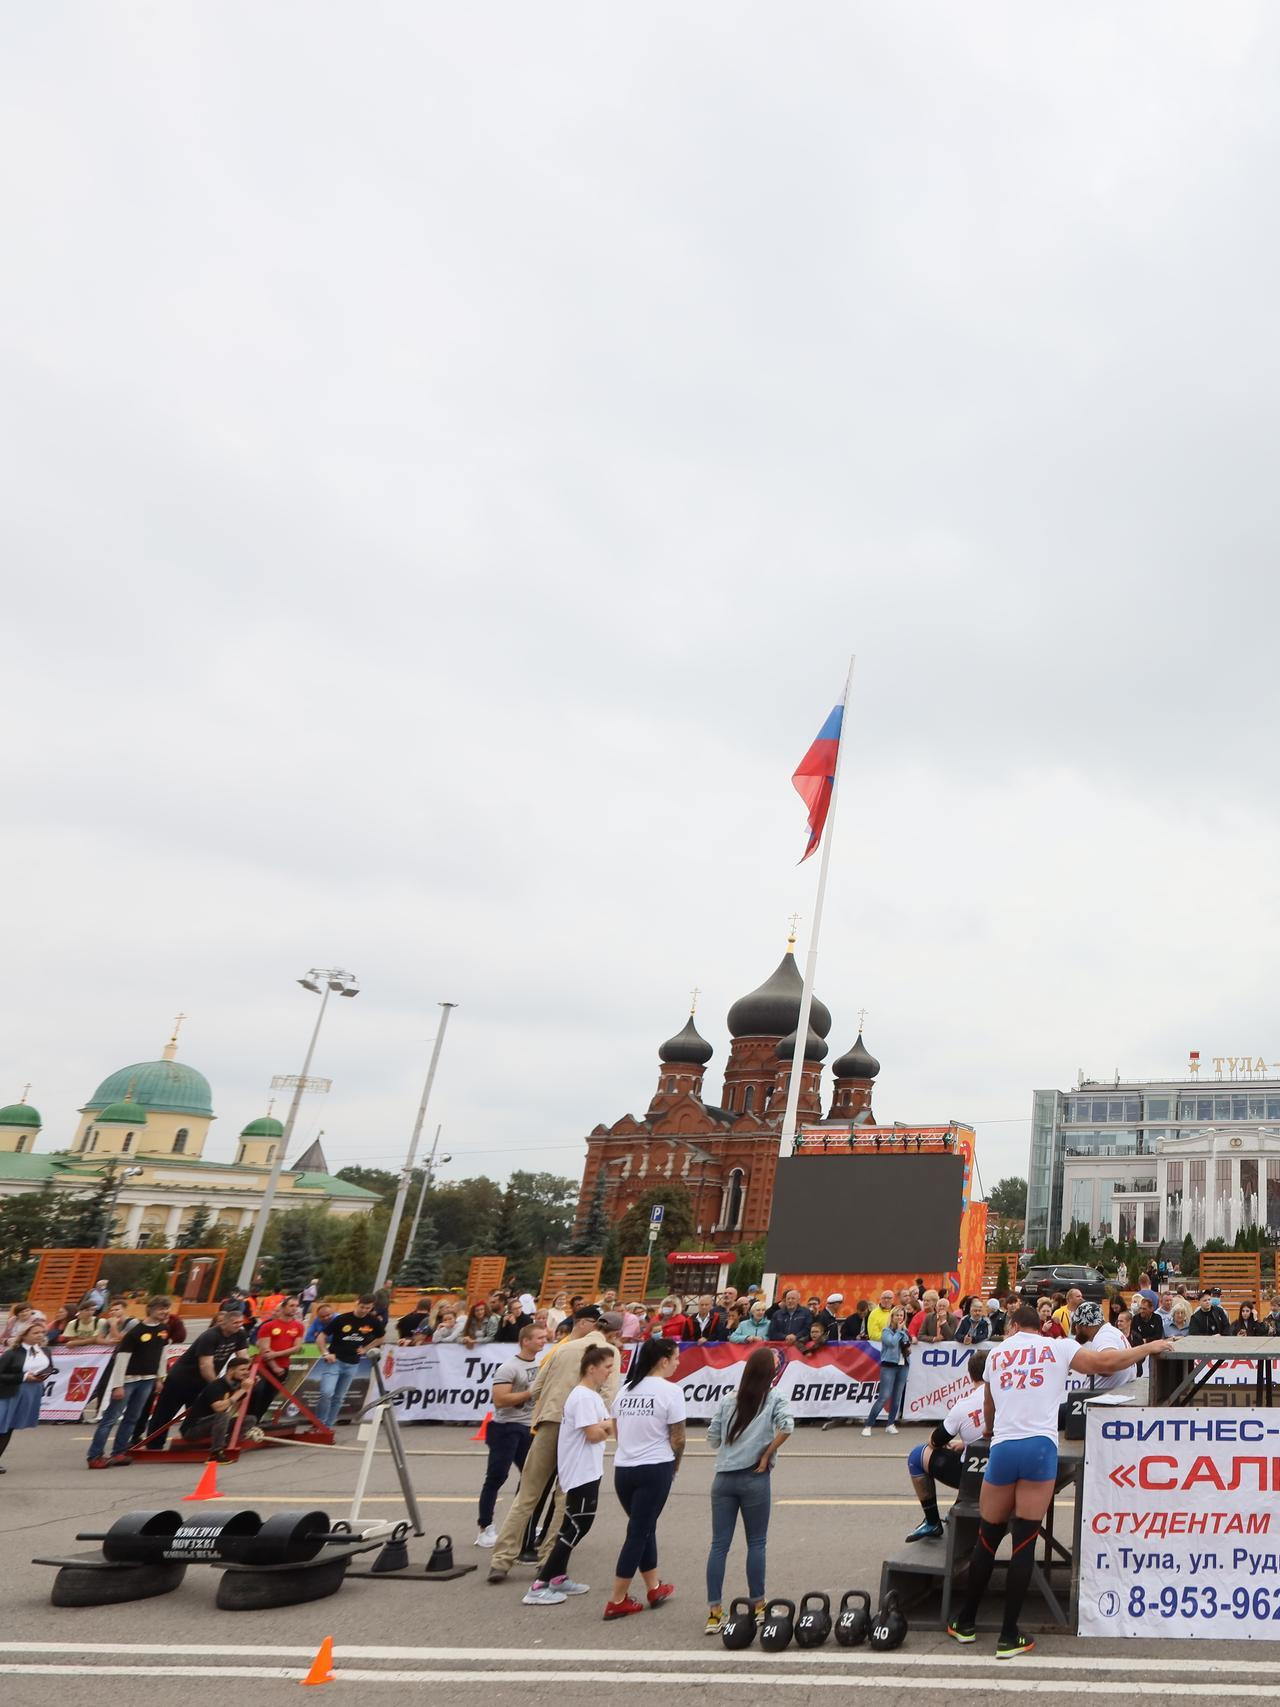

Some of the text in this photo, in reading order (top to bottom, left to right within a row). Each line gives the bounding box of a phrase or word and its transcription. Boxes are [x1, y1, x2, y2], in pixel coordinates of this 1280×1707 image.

[1212, 1055, 1268, 1074] ТУЛА
[991, 1345, 1056, 1371] ТУЛА
[1000, 1368, 1044, 1391] 875
[791, 1381, 880, 1403] ВПЕРЕД!
[620, 1398, 654, 1409] СИЛА
[1091, 1512, 1270, 1539] СТУДЕНТАМ
[1096, 1553, 1110, 1569] г.
[1118, 1548, 1181, 1574] Тула,
[1189, 1553, 1224, 1574] ул.
[800, 1616, 813, 1627] 32
[840, 1613, 854, 1627] 32
[723, 1623, 736, 1635] 24
[763, 1625, 777, 1638] 24
[873, 1626, 889, 1640] 40
